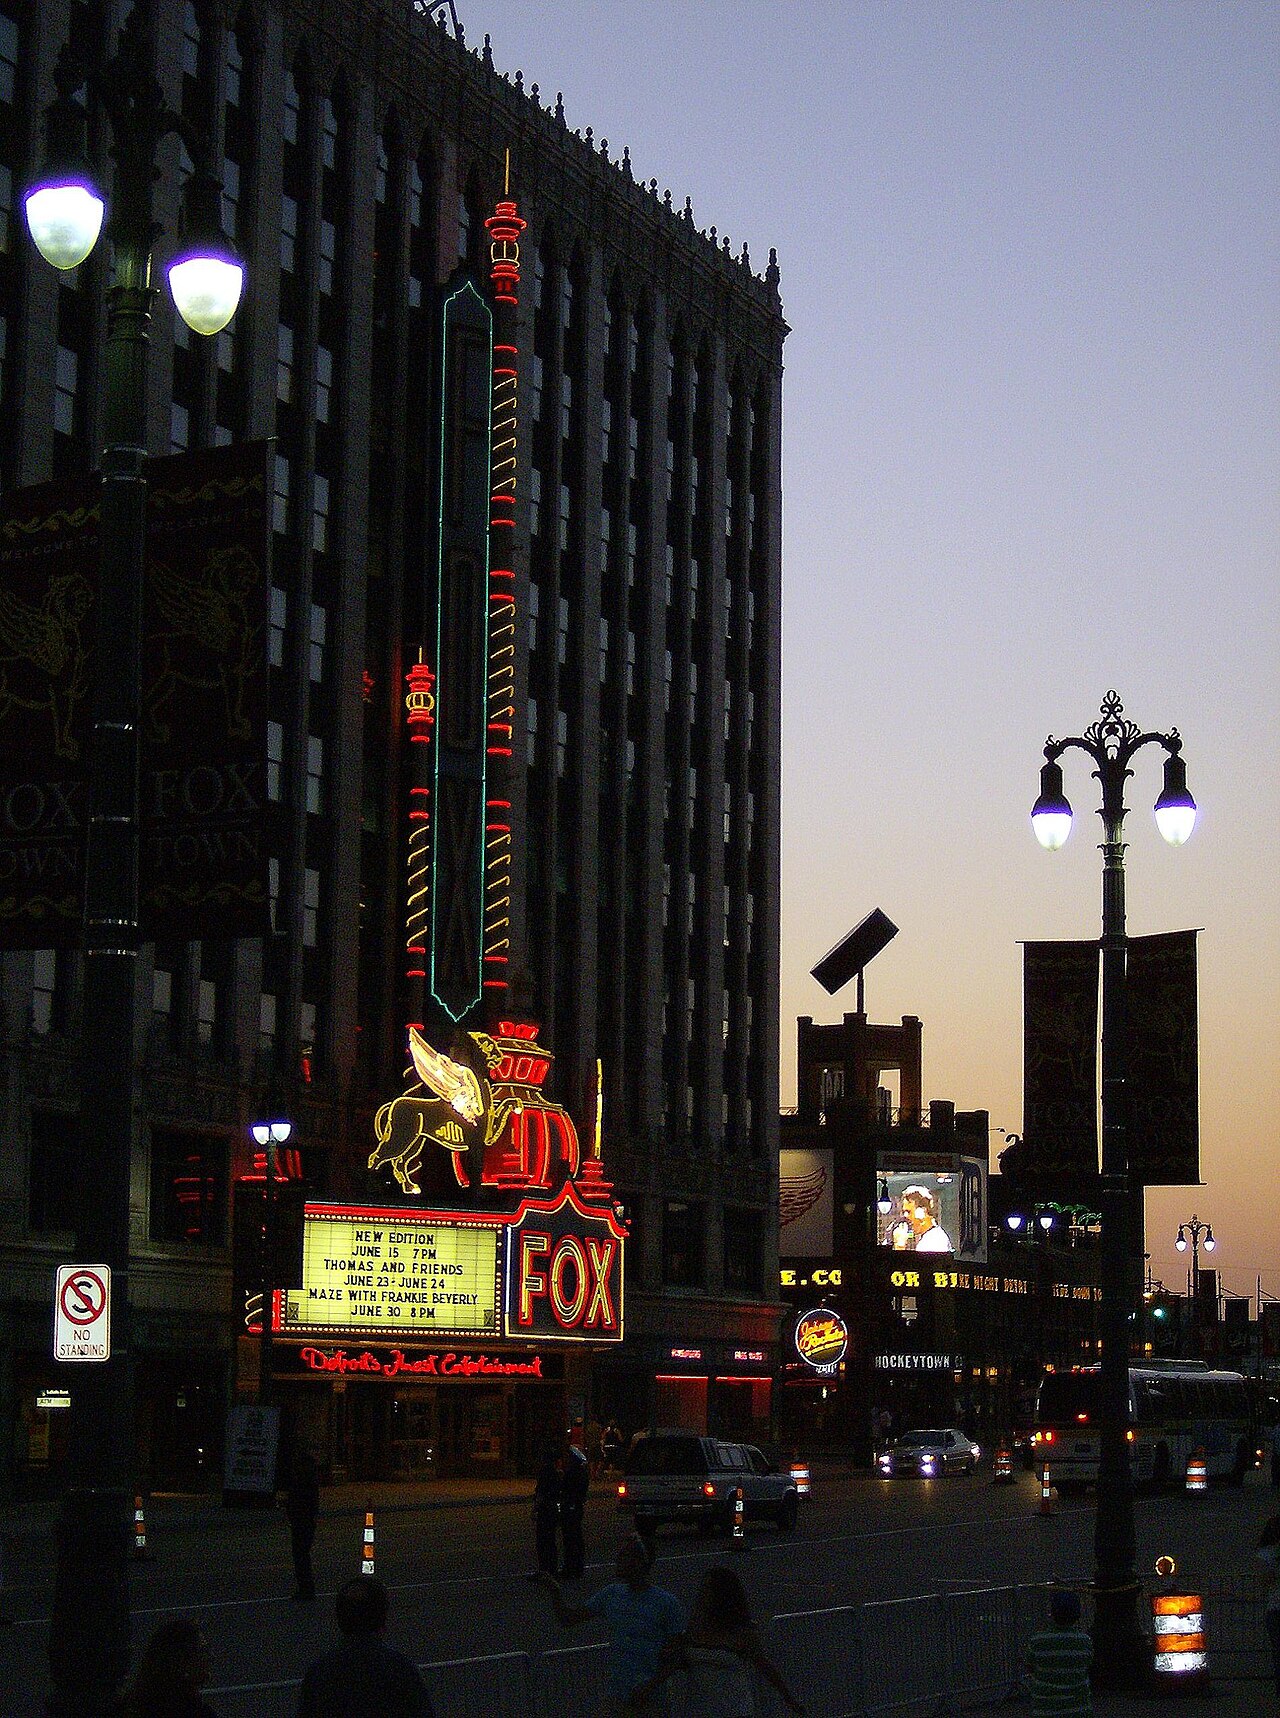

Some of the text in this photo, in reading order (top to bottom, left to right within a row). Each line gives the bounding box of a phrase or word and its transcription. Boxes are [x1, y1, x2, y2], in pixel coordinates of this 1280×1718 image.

[150, 762, 261, 818] FOX
[0, 783, 81, 832] OX
[150, 830, 261, 867] TOWN
[0, 846, 79, 879] OWN
[355, 1231, 434, 1245] NEW EDITION
[352, 1246, 381, 1257] JUNE
[389, 1247, 399, 1258] 15
[324, 1259, 463, 1275] THOMAS AND FRIENDS
[344, 1275, 373, 1286] JUNE
[376, 1276, 389, 1287] 23
[398, 1277, 427, 1289] JUNE
[431, 1278, 445, 1289] 24
[518, 1229, 619, 1330] FOX
[309, 1288, 478, 1305] MAZE WITH FRANKIE BEVERLY
[351, 1304, 382, 1317] JUNE
[387, 1306, 401, 1317] 30
[73, 1329, 91, 1341] NO
[60, 1344, 105, 1356] STANDING
[300, 1347, 381, 1374] Detroit's
[440, 1353, 544, 1378] Entertainment
[875, 1355, 950, 1369] HOCKEYTOWN
